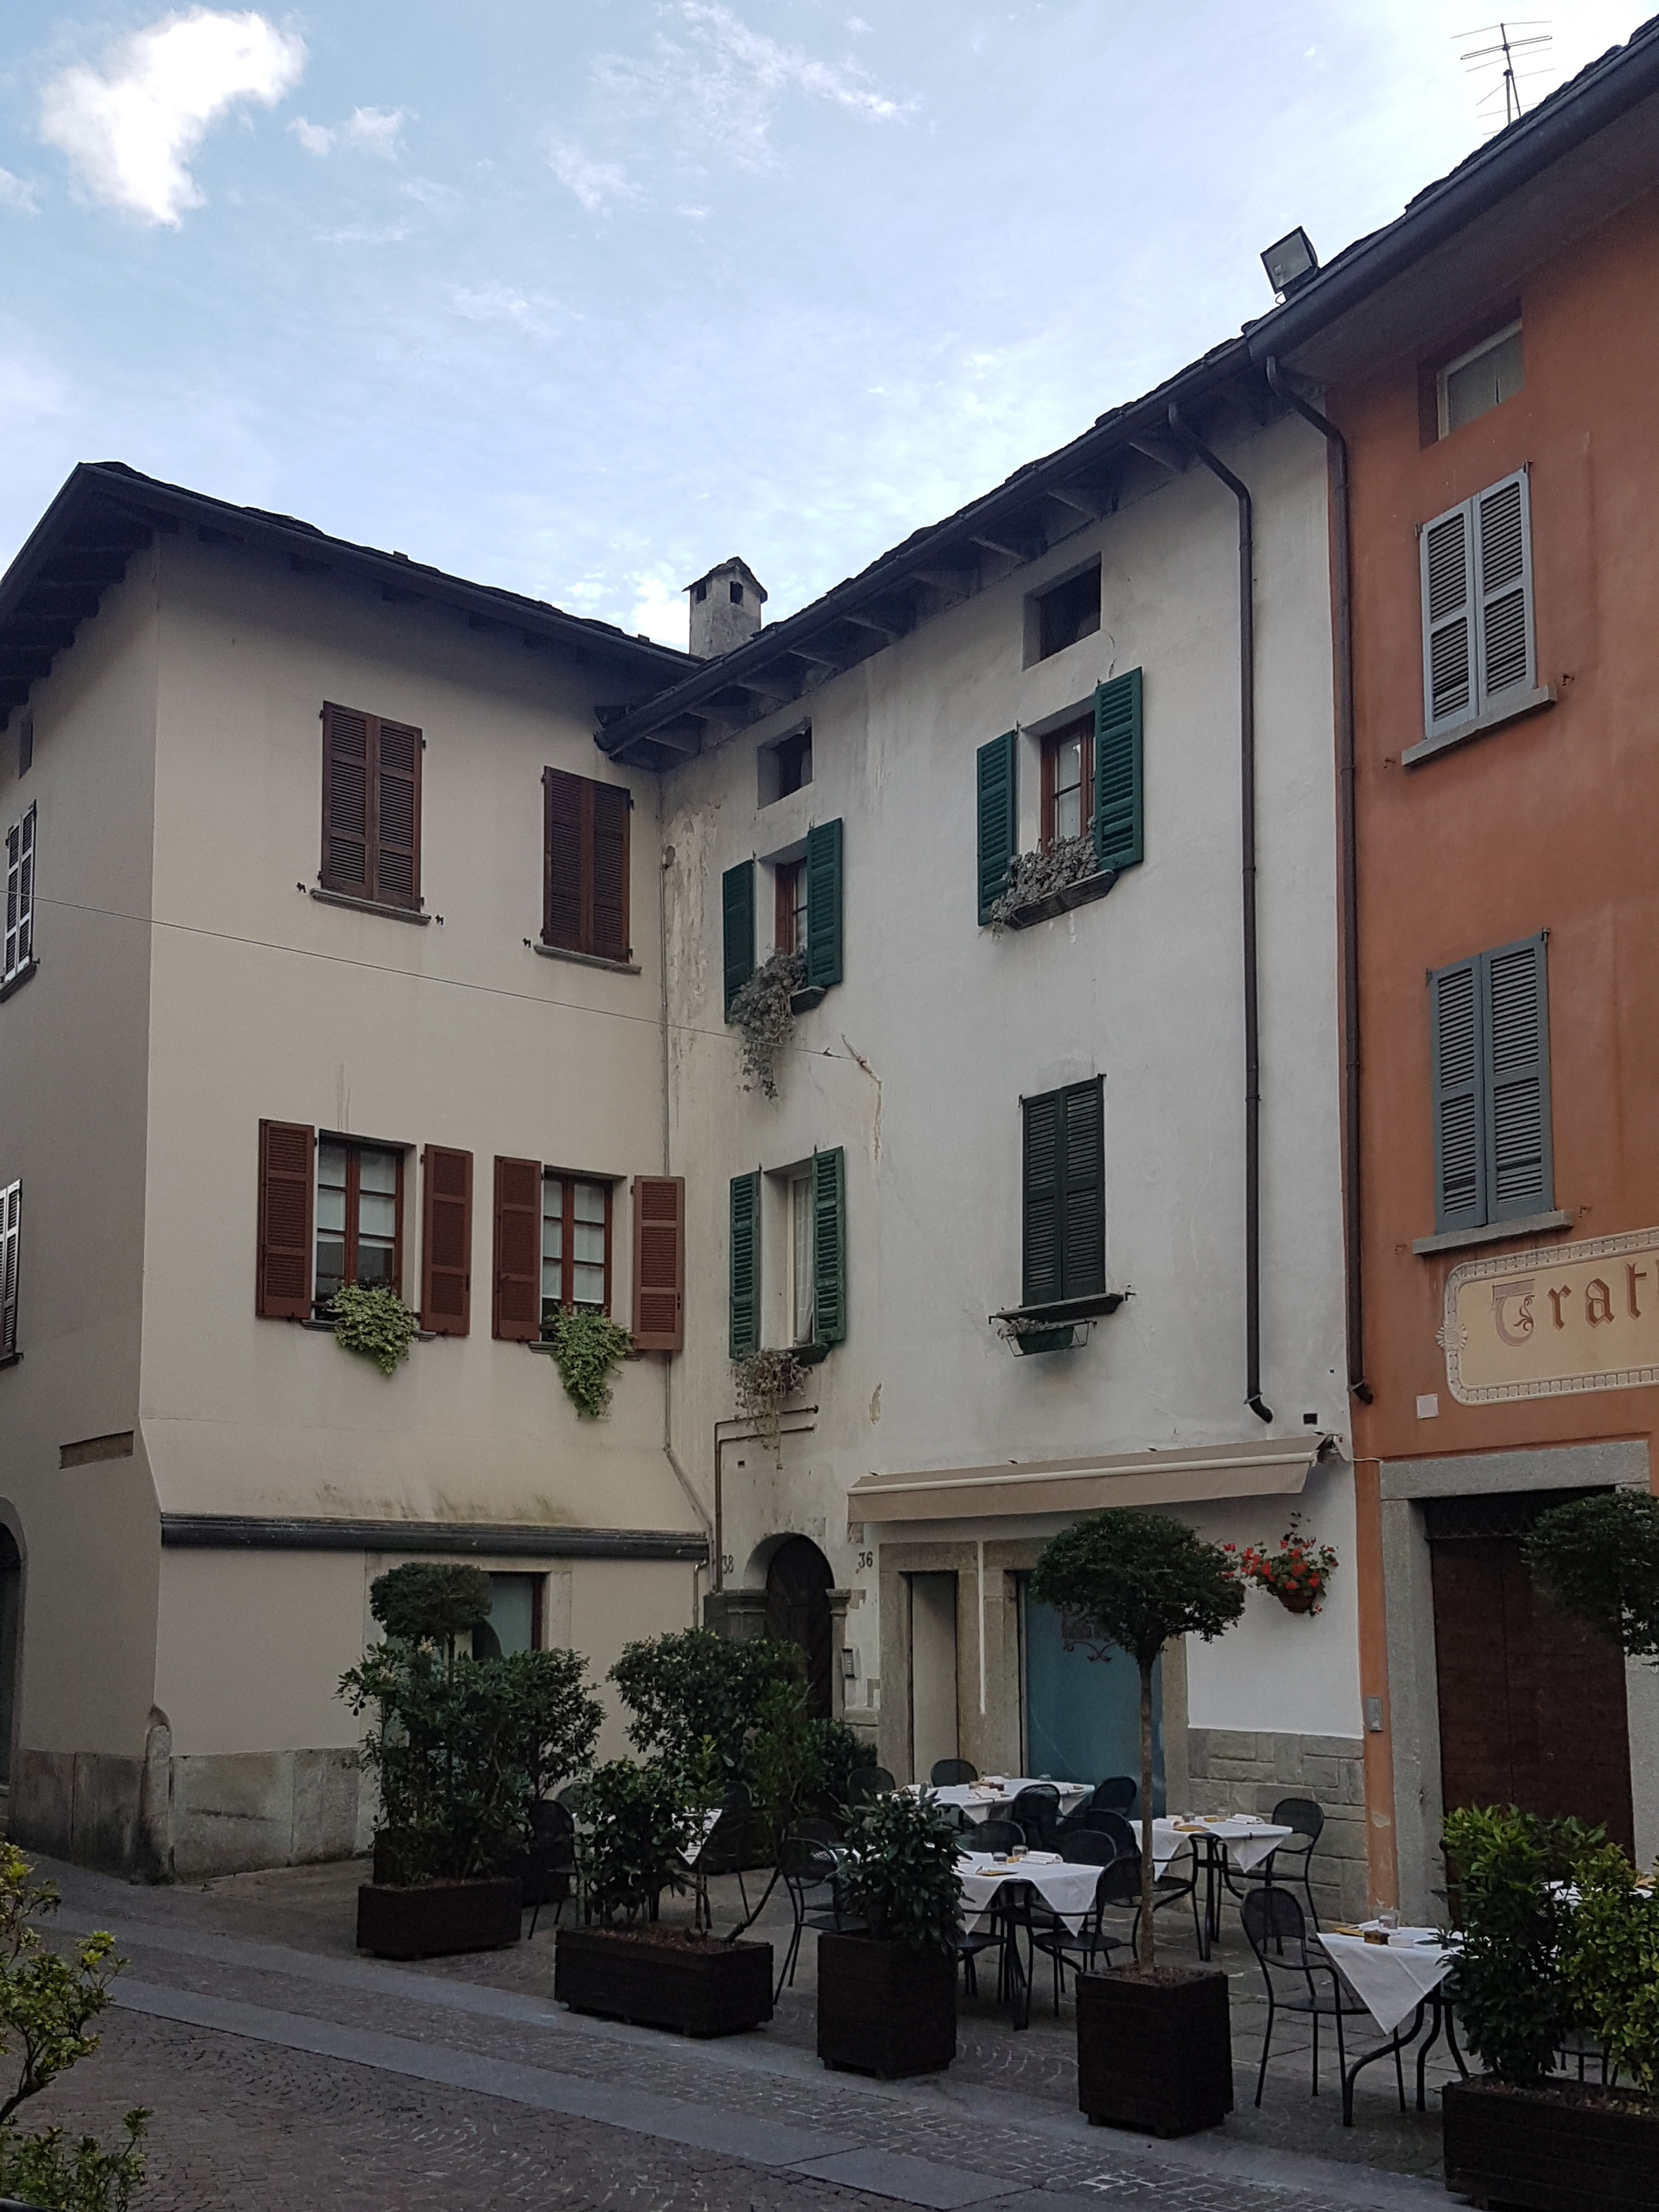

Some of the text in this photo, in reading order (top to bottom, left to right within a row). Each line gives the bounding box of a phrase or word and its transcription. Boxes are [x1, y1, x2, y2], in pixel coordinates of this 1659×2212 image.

[1491, 1259, 1659, 1347] Trat
[721, 1555, 734, 1574] 38
[858, 1551, 873, 1568] 36
